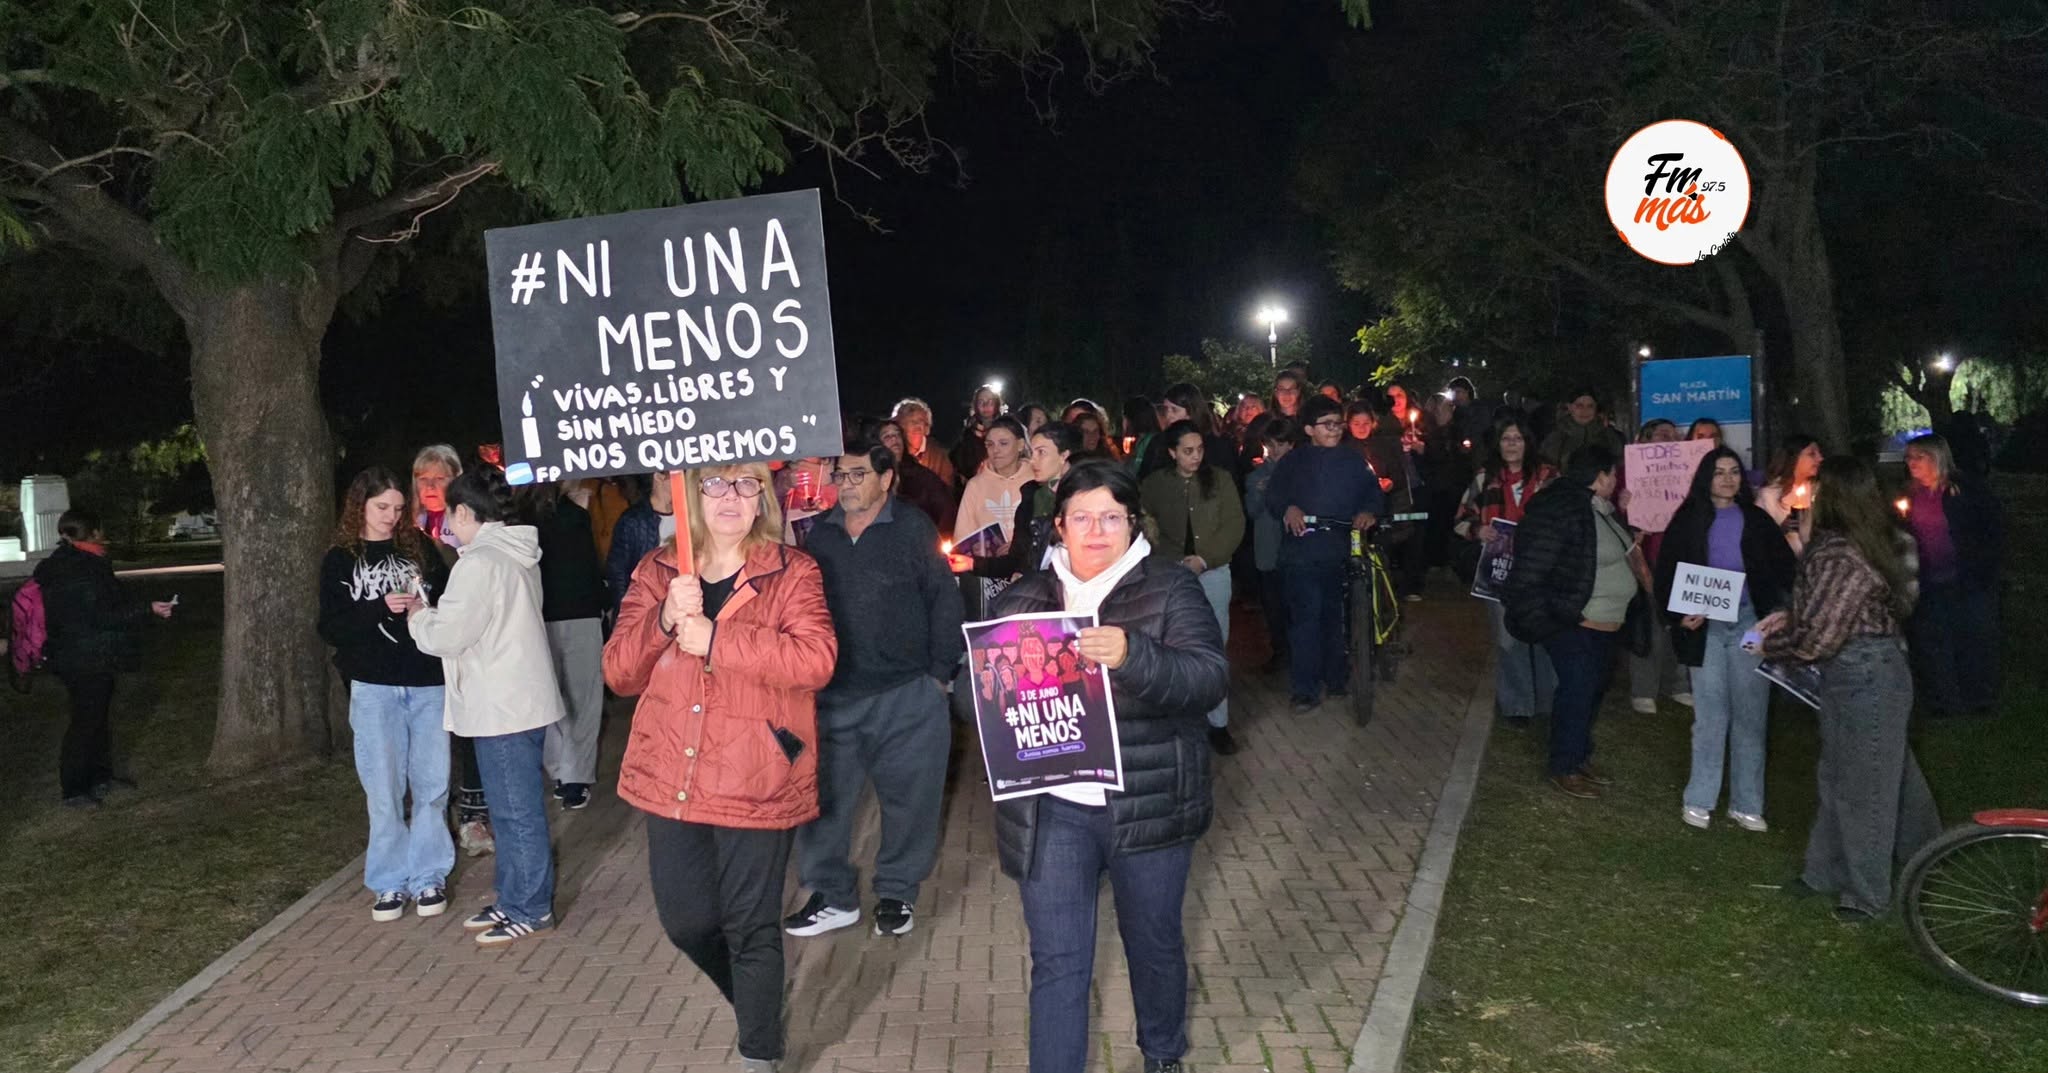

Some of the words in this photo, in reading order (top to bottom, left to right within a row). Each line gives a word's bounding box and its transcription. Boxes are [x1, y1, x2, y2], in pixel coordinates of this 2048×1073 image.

[663, 218, 801, 298] UNA
[598, 299, 809, 376] MENOS
[769, 366, 788, 391] Y
[1652, 392, 1681, 404] SAN
[1686, 386, 1740, 402] MARTÍN
[557, 415, 604, 441] SIN
[563, 442, 627, 472] NOS
[1638, 443, 1682, 461] TODAS
[536, 466, 561, 483] FP
[1685, 573, 1700, 586] NI
[1703, 575, 1732, 592] UNA
[1681, 590, 1731, 610] MENOS
[1020, 690, 1026, 702] 3
[1026, 689, 1038, 701] DE
[1039, 686, 1059, 700] JUNIO
[1005, 701, 1040, 727] #NI
[1042, 693, 1087, 722] UNA
[1014, 717, 1082, 750] MENOS
